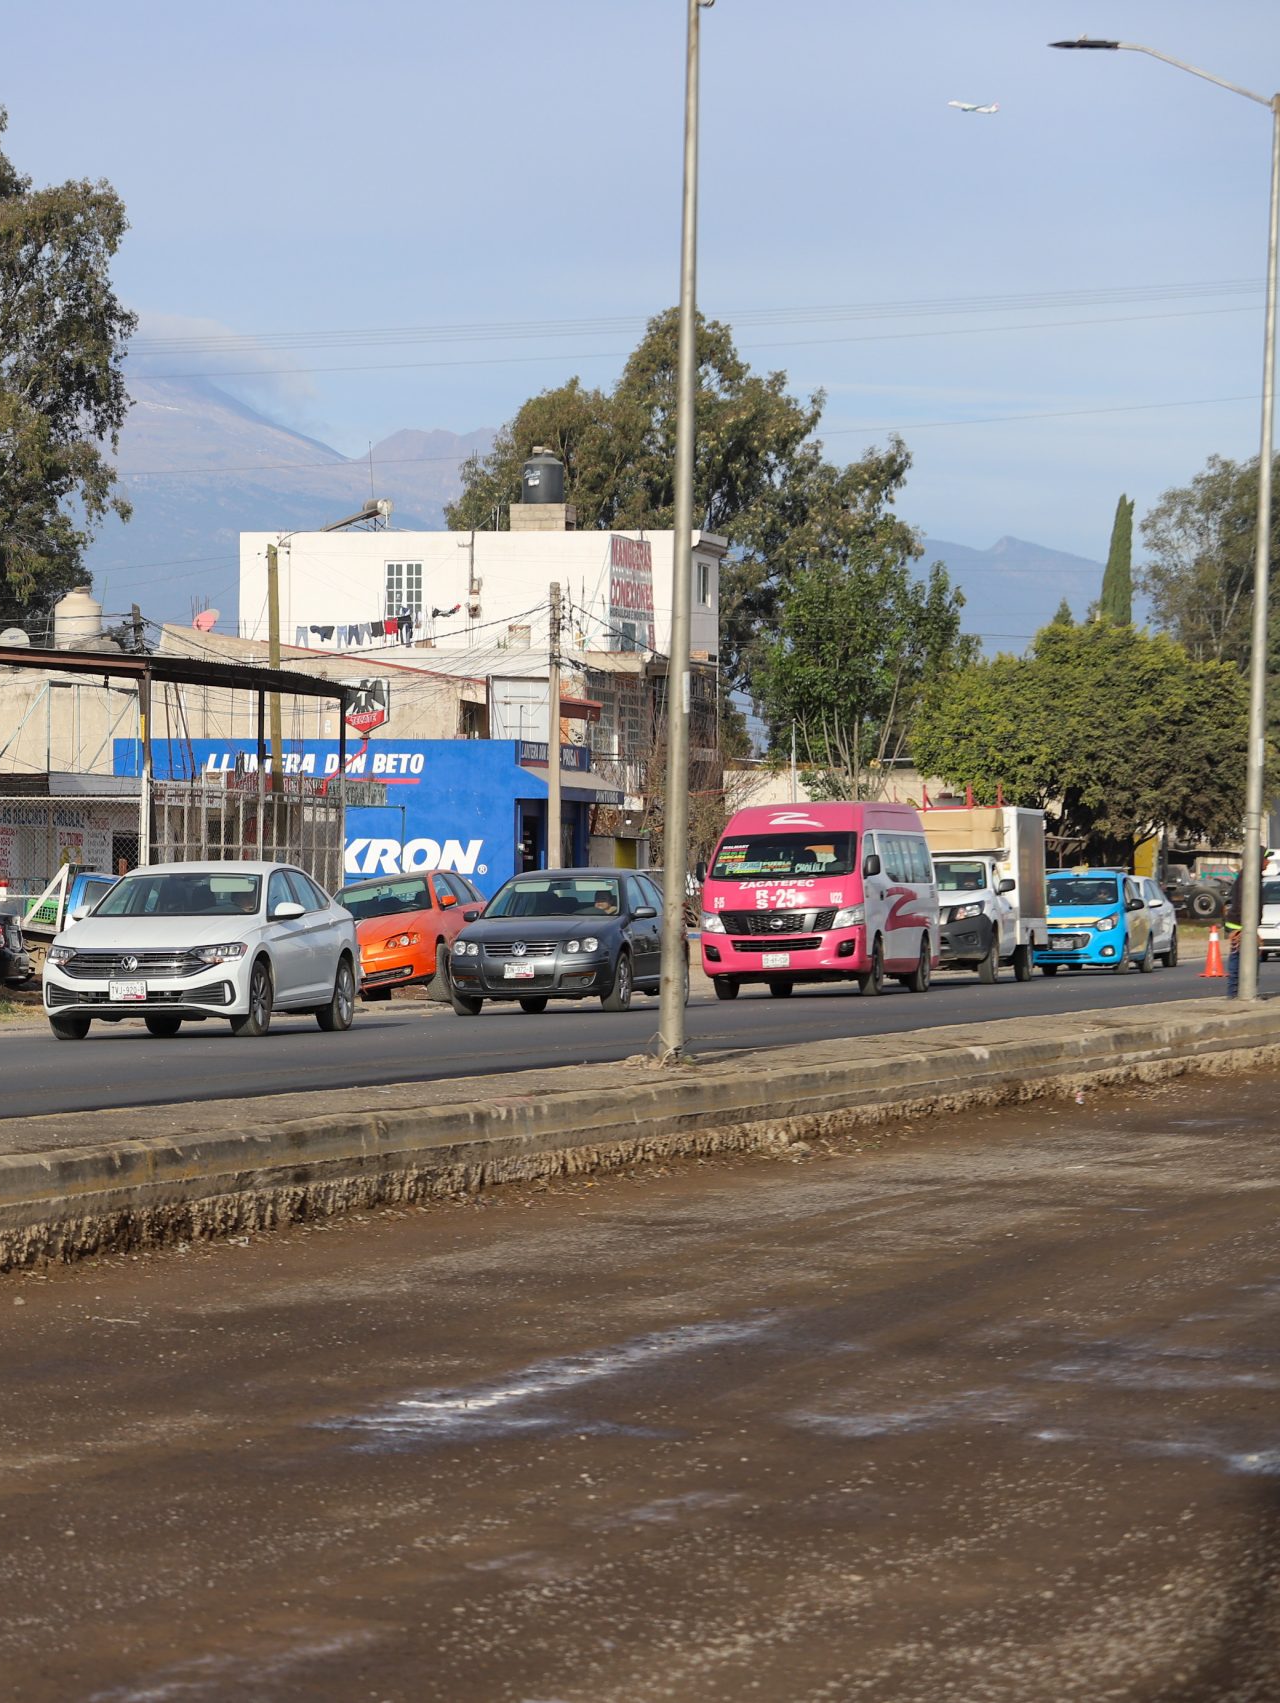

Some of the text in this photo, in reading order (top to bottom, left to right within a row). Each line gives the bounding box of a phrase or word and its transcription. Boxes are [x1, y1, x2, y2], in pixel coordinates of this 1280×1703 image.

[372, 753, 425, 774] BETO
[794, 862, 827, 874] CHOLULA
[739, 880, 815, 890] ZACATEPEC
[756, 889, 769, 899] R
